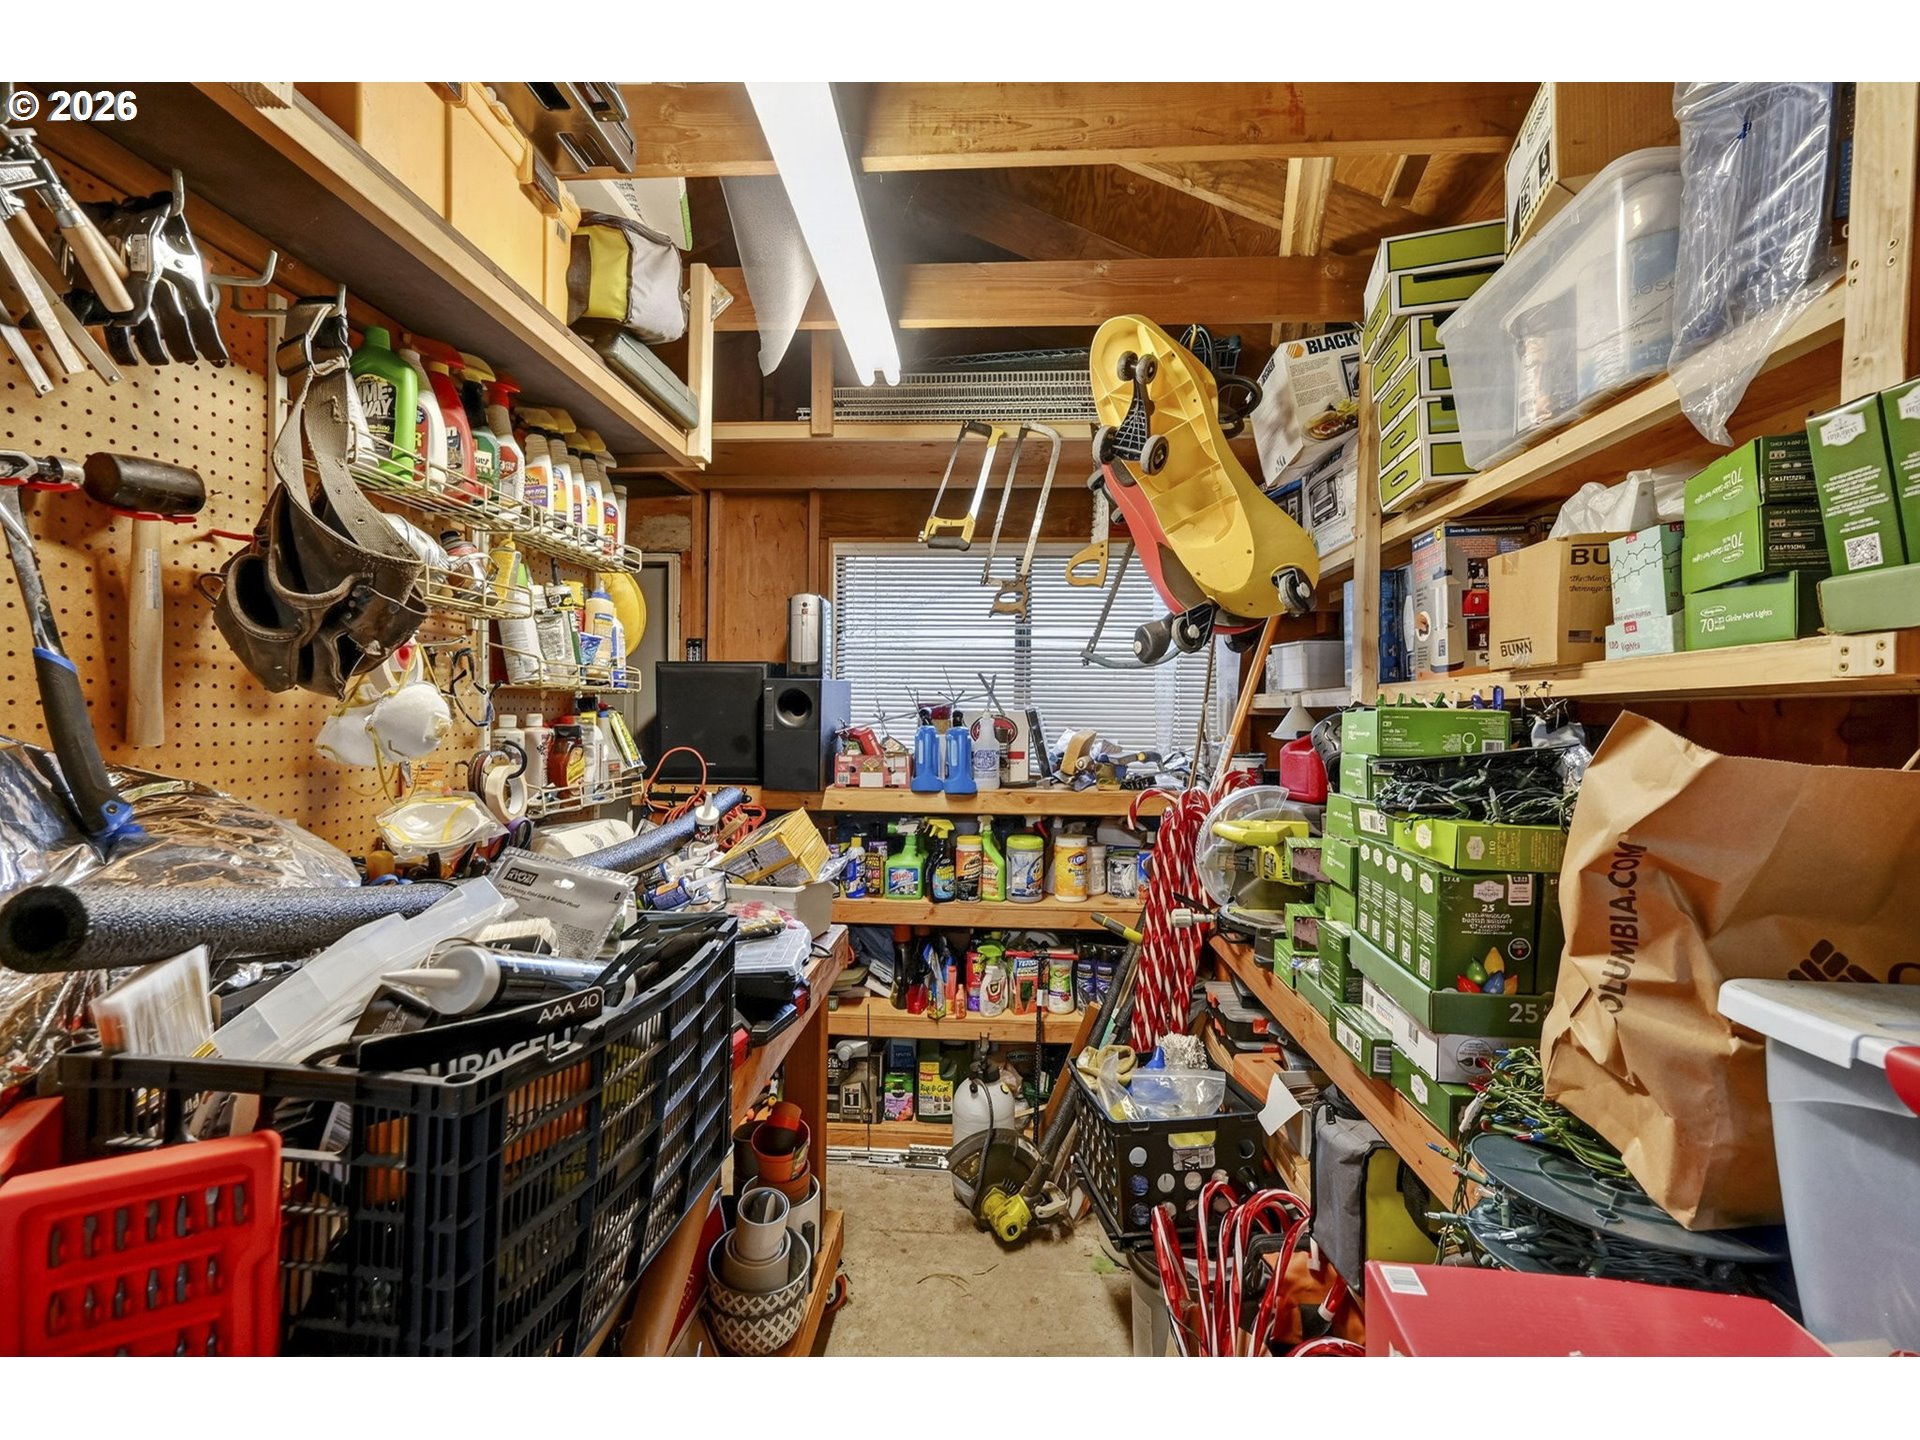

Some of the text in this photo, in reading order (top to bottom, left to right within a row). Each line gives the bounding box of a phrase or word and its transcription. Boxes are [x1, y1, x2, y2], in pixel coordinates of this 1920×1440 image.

[1305, 331, 1359, 355] BLACK
[1700, 617, 1714, 633] 70
[1500, 640, 1533, 659] BUNN
[1481, 903, 1496, 913] 25
[1598, 841, 1648, 1030] OLUMBIA.COM
[537, 993, 599, 1024] AAA 40
[1508, 1002, 1540, 1024] 25
